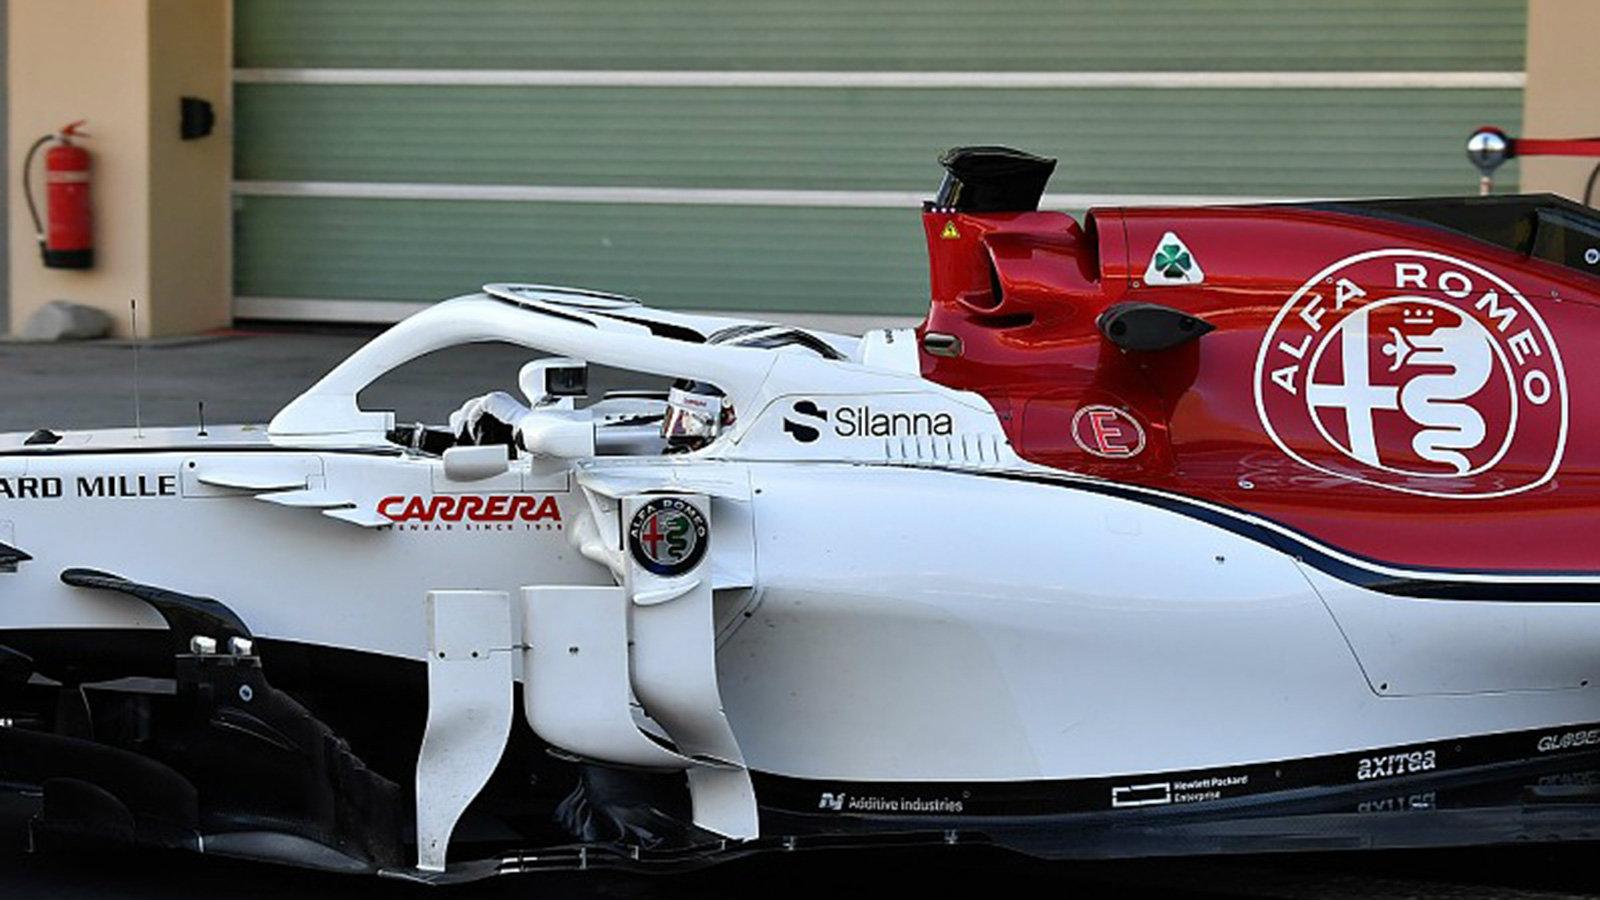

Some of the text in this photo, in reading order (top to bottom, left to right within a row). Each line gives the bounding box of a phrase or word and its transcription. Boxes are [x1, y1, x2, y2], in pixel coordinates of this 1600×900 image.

[1271, 262, 1552, 405] ALFA ROMEO
[835, 406, 953, 437] Silanna
[1089, 411, 1129, 453] E
[76, 475, 176, 497] MILLE
[377, 496, 561, 521] CARRERA
[631, 500, 705, 538] ALFA ROMEO
[1211, 775, 1248, 786] Packard
[849, 797, 963, 812] Additive industries
